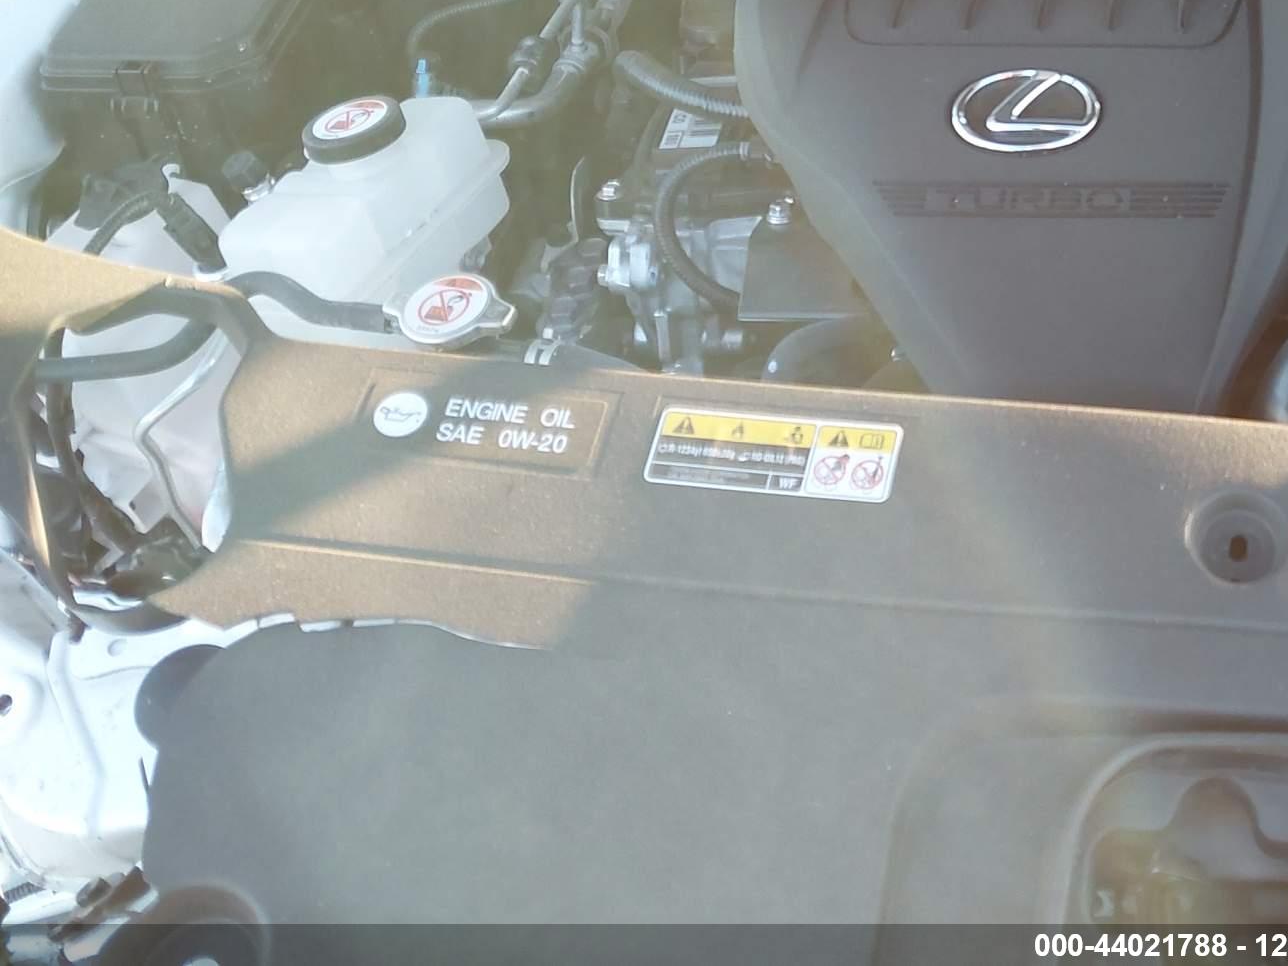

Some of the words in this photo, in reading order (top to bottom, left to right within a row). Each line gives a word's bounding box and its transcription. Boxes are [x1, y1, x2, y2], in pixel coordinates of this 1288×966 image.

[445, 399, 528, 424] ENGINE
[540, 405, 576, 429] OIL
[436, 423, 484, 445] SAE
[498, 431, 568, 454] 0W-20
